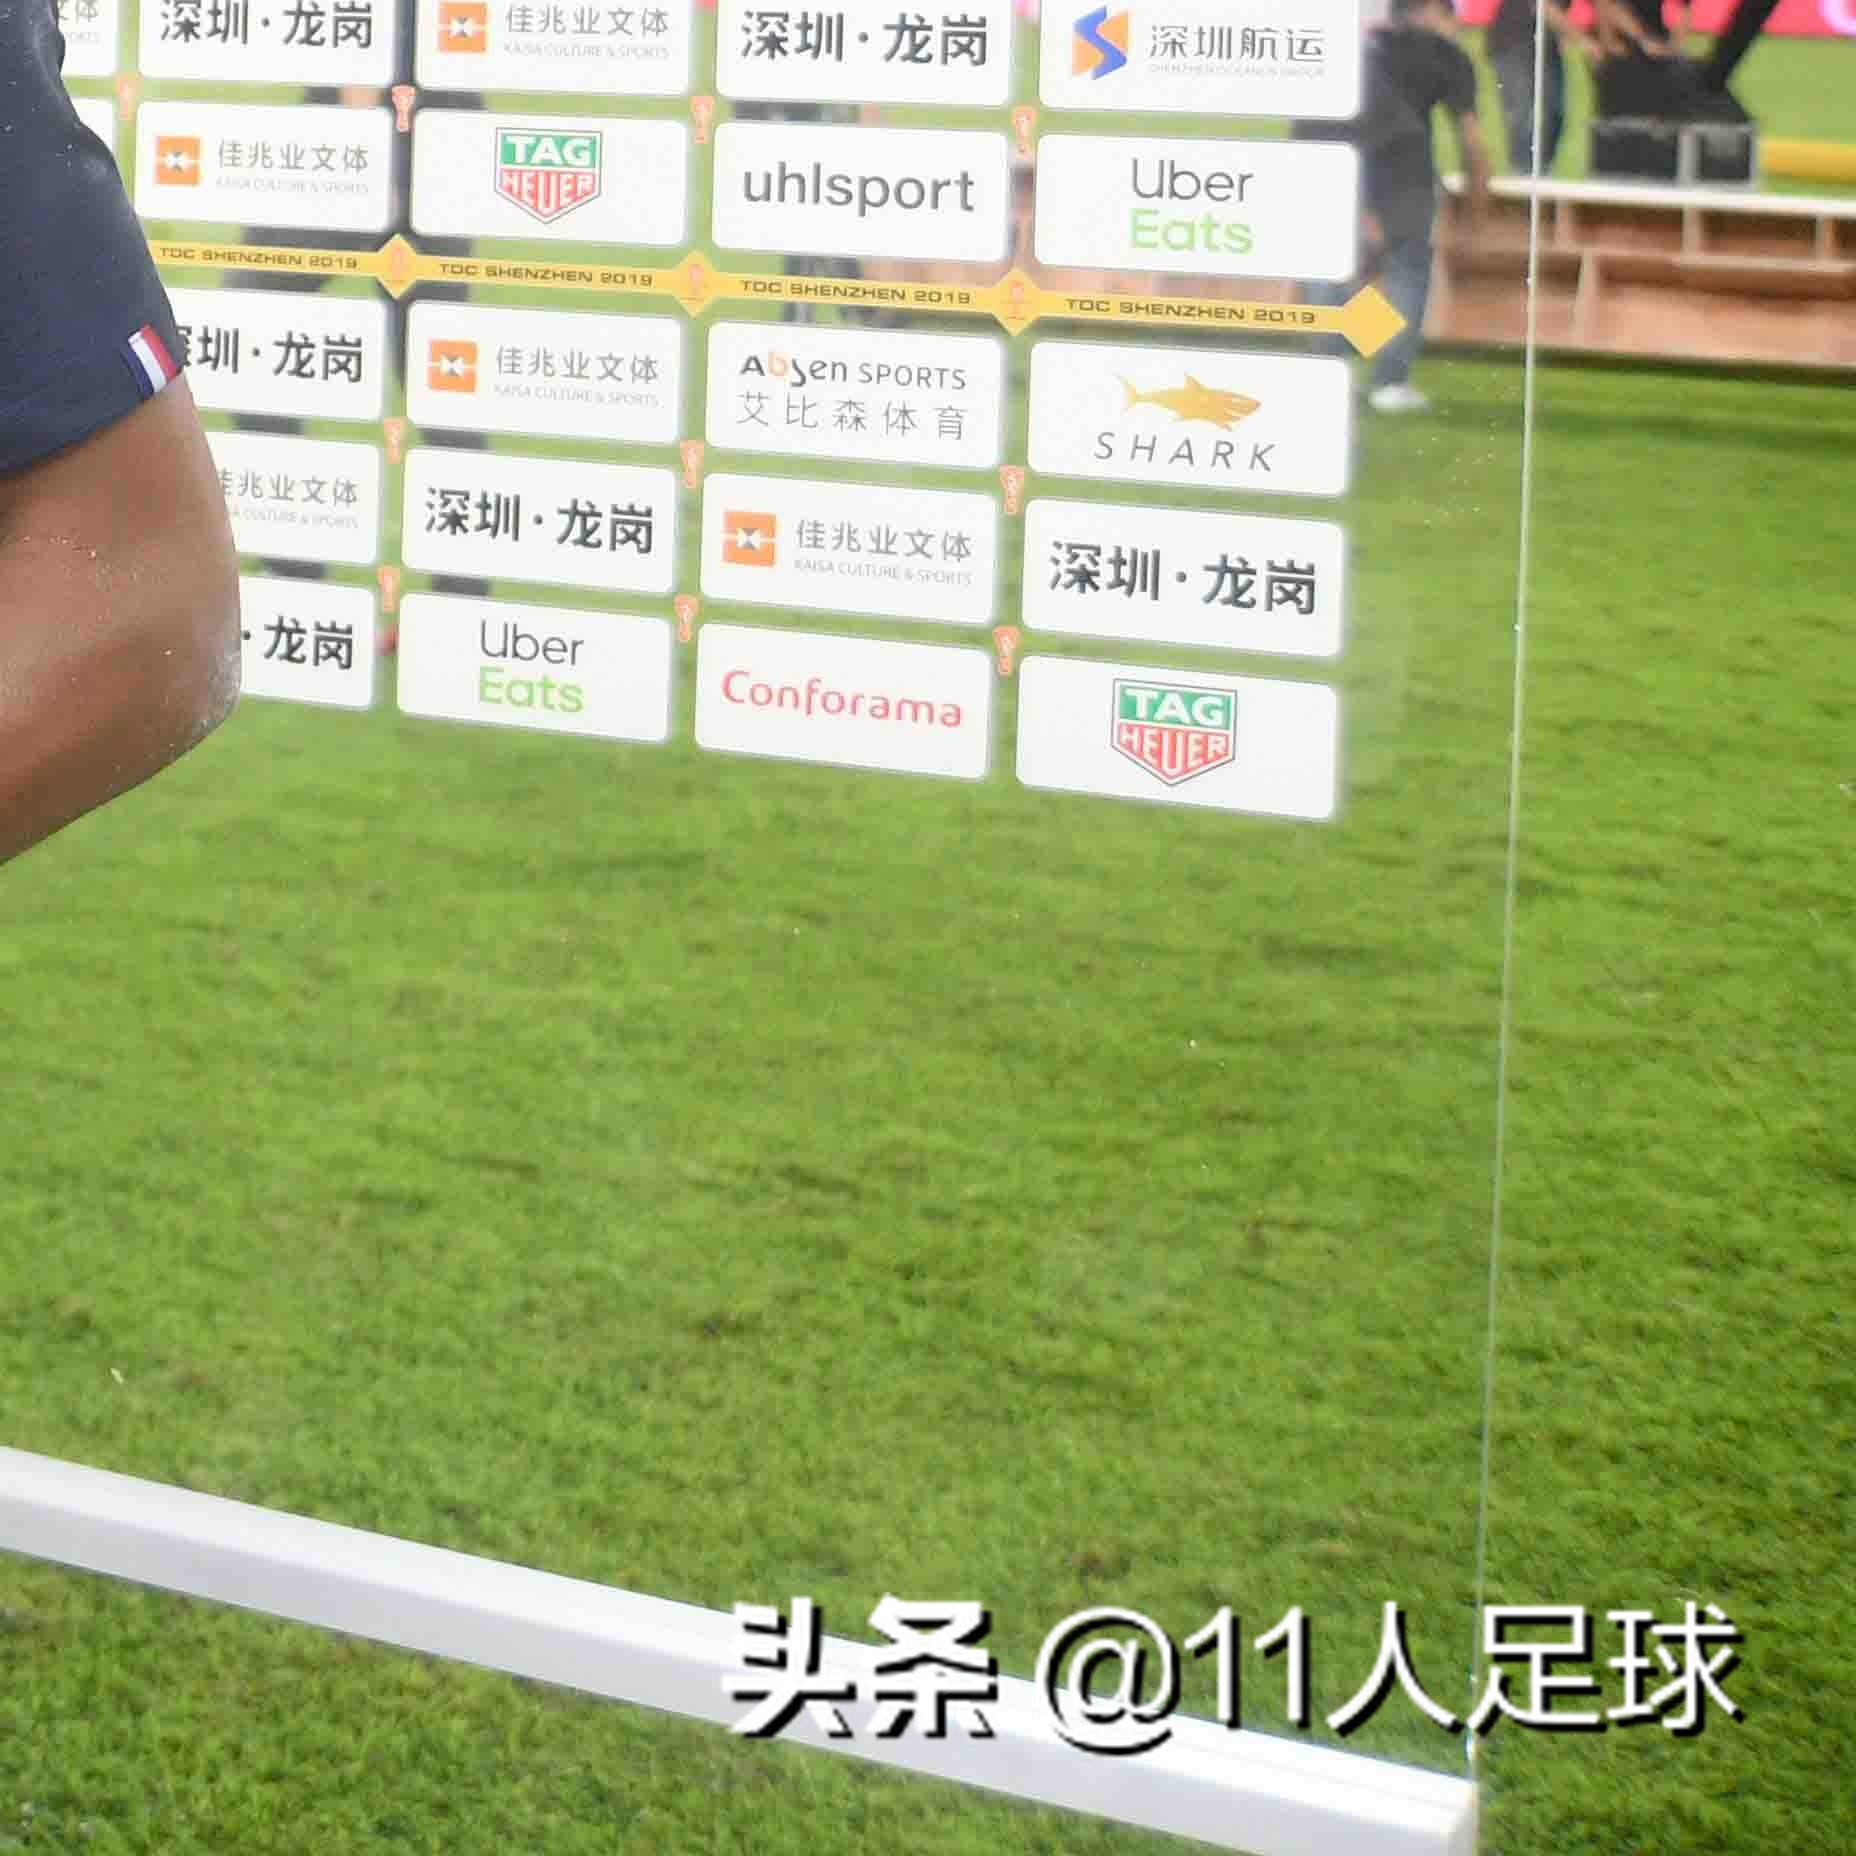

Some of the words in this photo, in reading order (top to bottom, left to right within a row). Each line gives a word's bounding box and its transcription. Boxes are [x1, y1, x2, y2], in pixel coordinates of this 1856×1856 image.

[505, 5, 668, 37] 佳兆业文体
[1150, 26, 1323, 62] 深圳航运
[219, 140, 368, 173] 佳兆业文体
[508, 135, 592, 163] TAG
[503, 170, 594, 217] HEUER
[744, 161, 974, 217] uhlsport
[1133, 158, 1254, 202] Uber
[1131, 208, 1253, 256] Eats
[160, 248, 194, 260] TDC
[201, 250, 302, 266] SHENZHEN
[309, 256, 357, 269] 2019
[440, 264, 475, 276] TDC
[484, 266, 593, 282] SHENZHEN
[601, 272, 652, 286] 2019
[741, 280, 782, 293] TDC
[791, 283, 906, 300] SHENZHEN
[915, 289, 971, 304] 2019
[1067, 299, 1110, 313] TDC
[1120, 302, 1245, 320] SHENZHEN
[1254, 309, 1314, 324] 2019
[496, 347, 658, 384] 佳兆业文体
[859, 363, 966, 390] SPORTS
[736, 392, 967, 440] 艾比森体育
[1094, 432, 1275, 472] SHARK
[795, 520, 971, 562] 佳兆业文体
[480, 620, 584, 665] Uber
[479, 667, 584, 712] Eats
[721, 670, 962, 728] Conforama
[1125, 687, 1225, 723] TAG
[1119, 725, 1228, 778] HEUER
